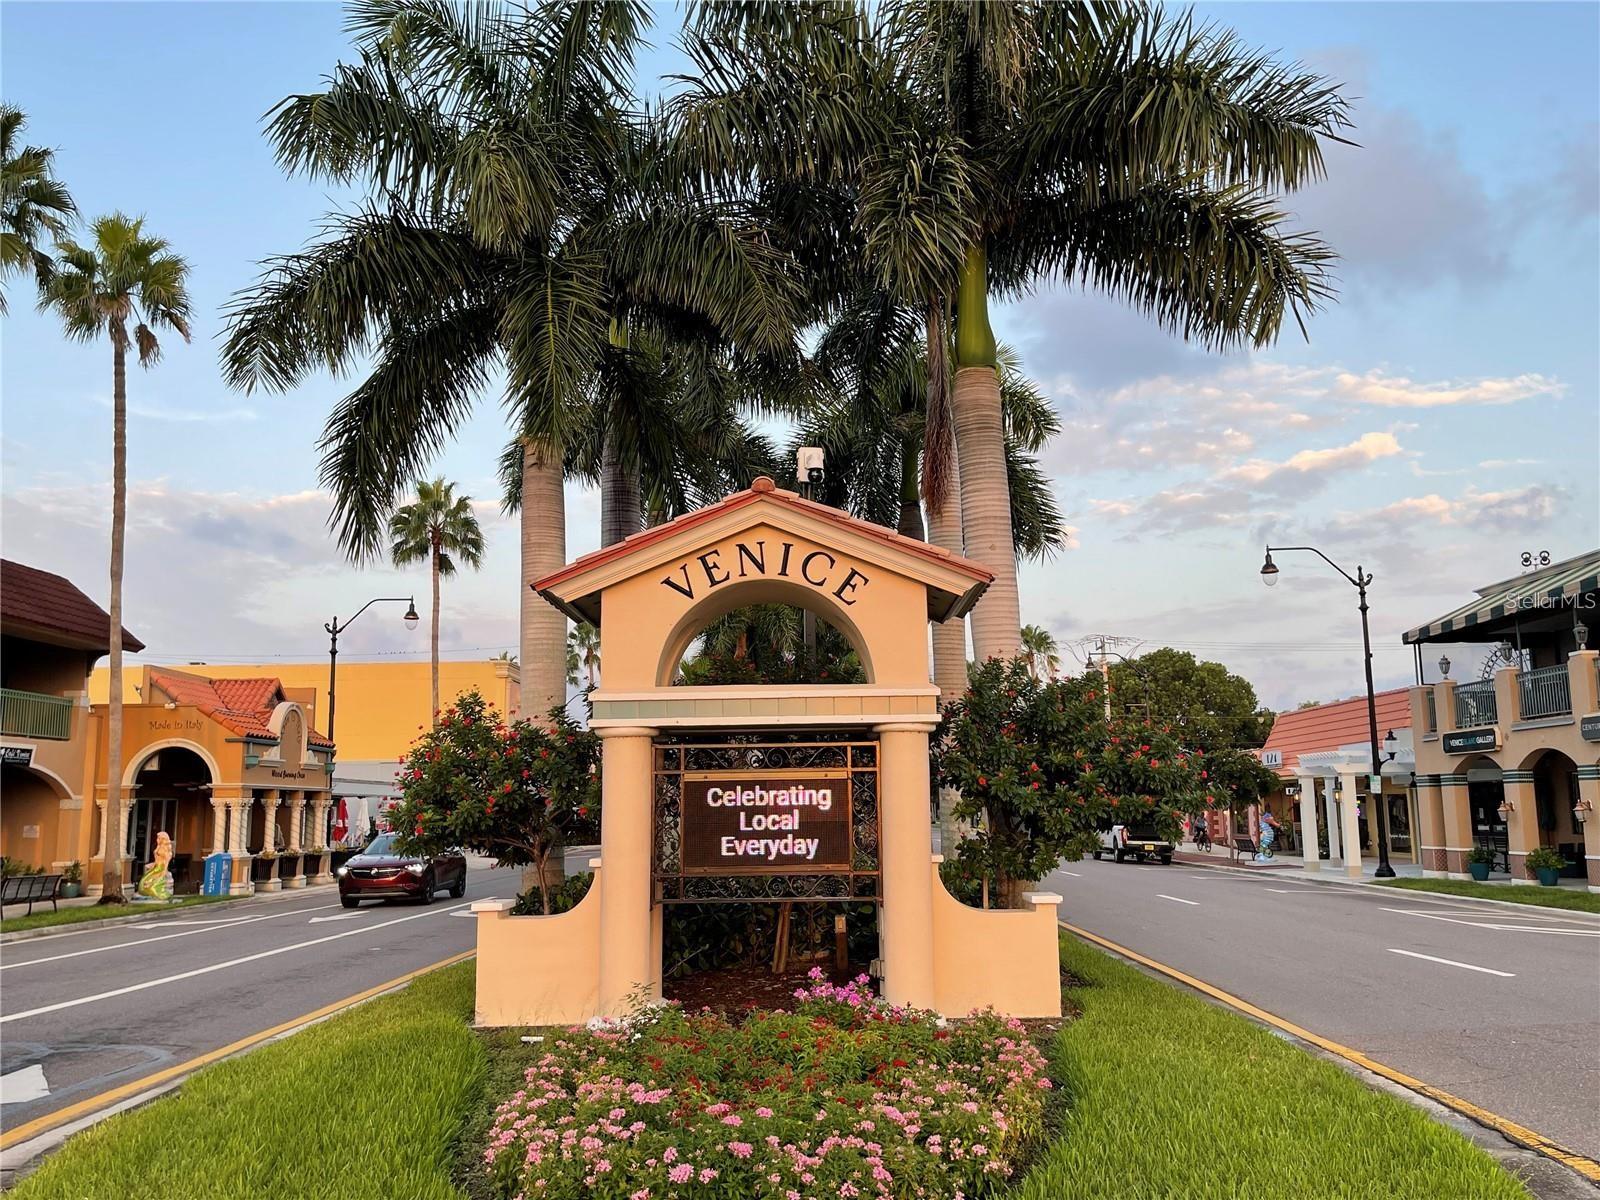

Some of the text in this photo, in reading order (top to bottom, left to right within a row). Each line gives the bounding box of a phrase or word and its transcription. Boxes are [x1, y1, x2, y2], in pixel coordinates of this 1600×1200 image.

[660, 541, 870, 606] VENICE
[149, 720, 171, 730] Made
[186, 719, 203, 731] Italy
[707, 785, 832, 811] Celebrating
[739, 809, 800, 831] Local
[720, 834, 819, 860] Everyday
